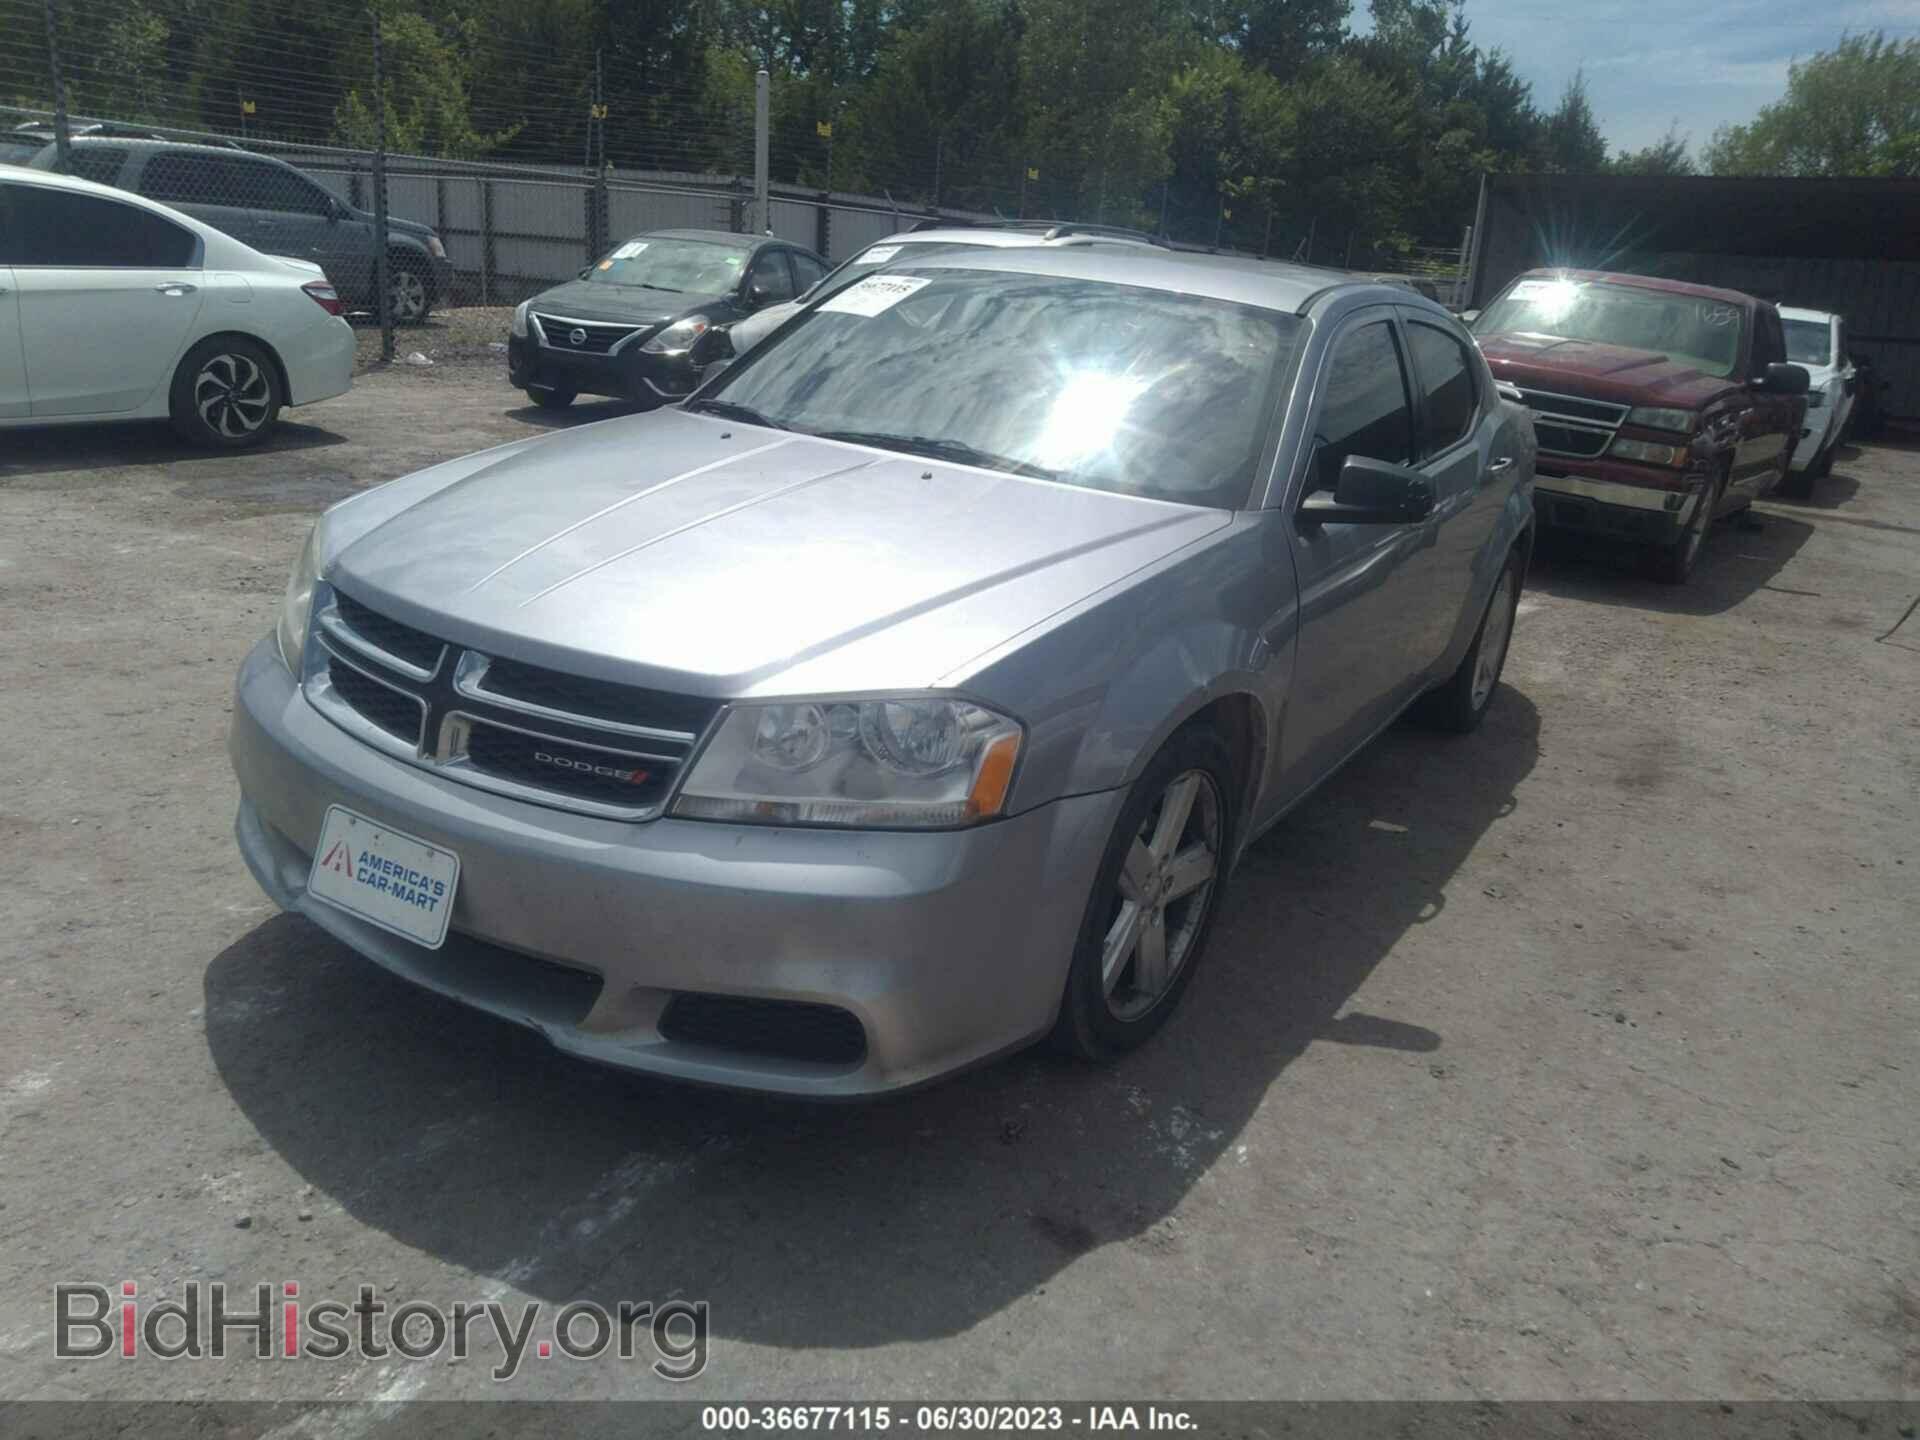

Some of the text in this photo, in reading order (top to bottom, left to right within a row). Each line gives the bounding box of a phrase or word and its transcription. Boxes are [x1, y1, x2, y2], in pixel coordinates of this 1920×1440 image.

[534, 752, 633, 780] DODGE
[357, 867, 438, 912] CAR-MART
[358, 851, 445, 896] AMERICA'S
